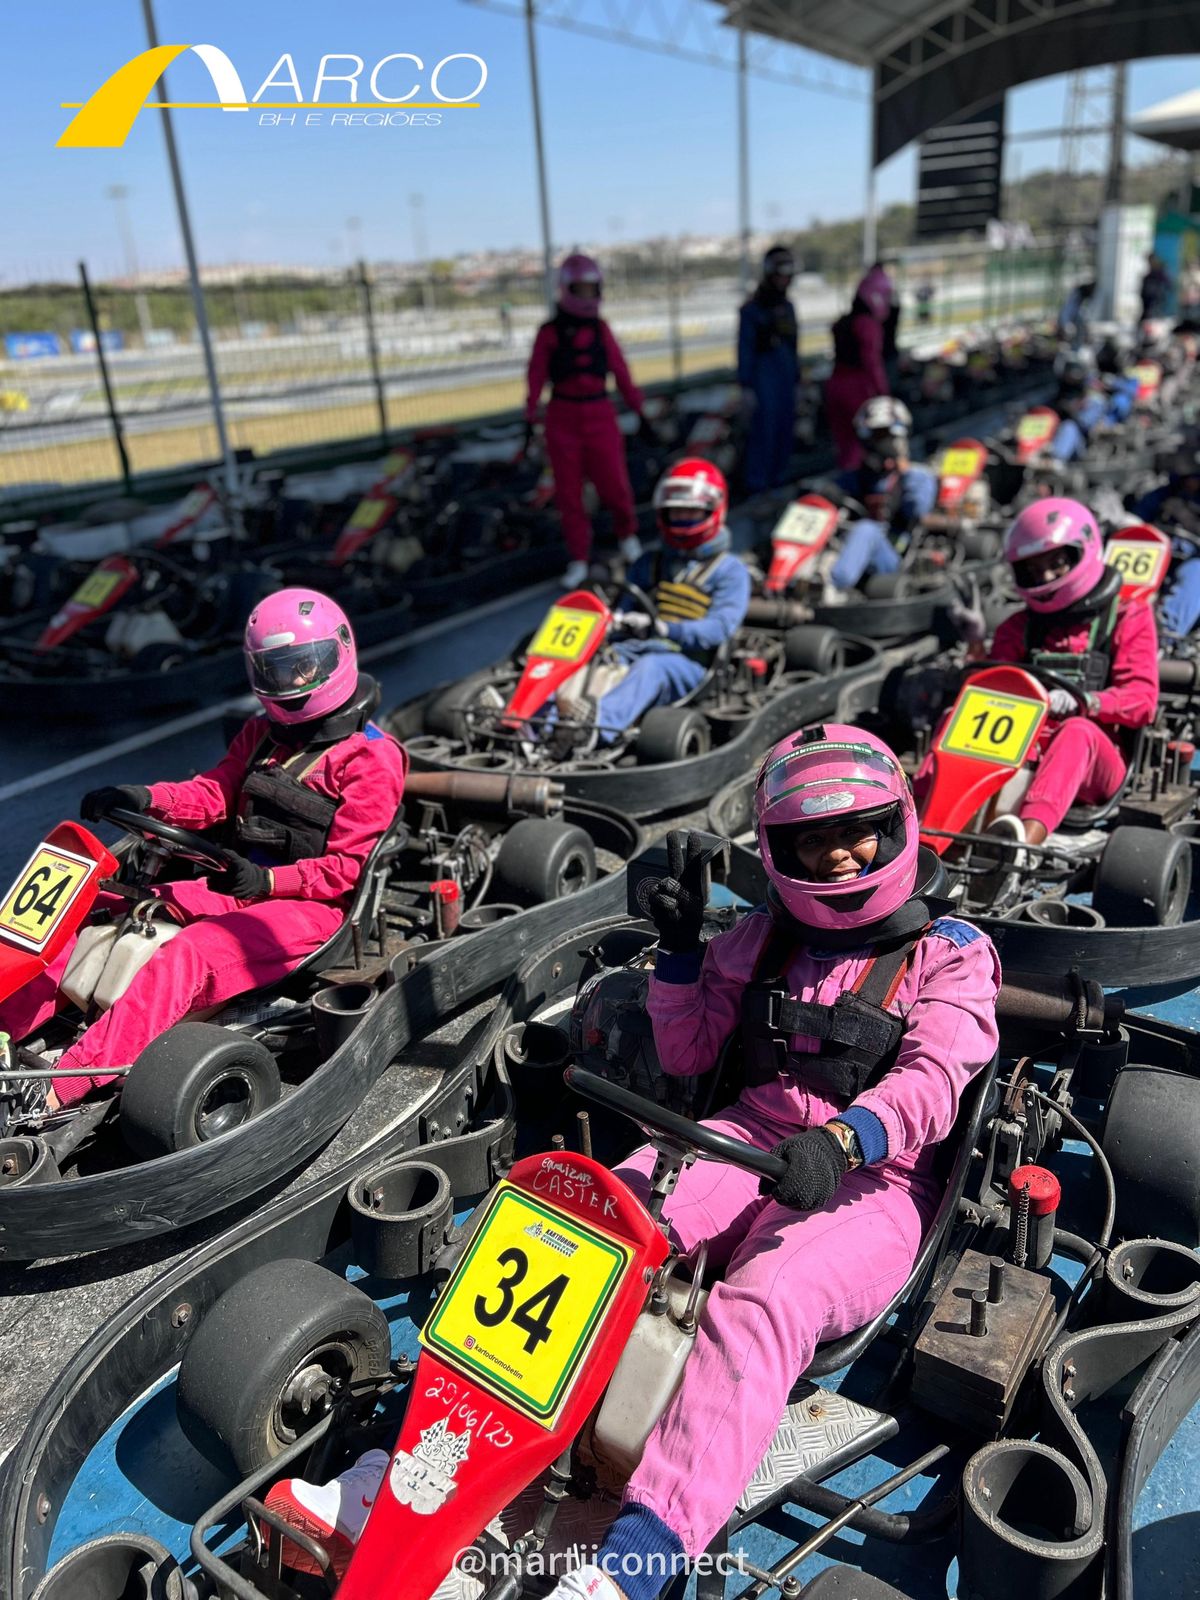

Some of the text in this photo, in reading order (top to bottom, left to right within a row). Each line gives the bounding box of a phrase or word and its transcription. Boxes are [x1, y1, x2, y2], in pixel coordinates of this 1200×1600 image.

[1113, 552, 1152, 576] 66
[550, 623, 580, 647] 16
[972, 710, 1015, 745] 10
[13, 866, 74, 926] 64
[533, 1169, 618, 1219] CASTER
[474, 1247, 570, 1355] 34
[475, 1344, 523, 1380] kartodromobetim
